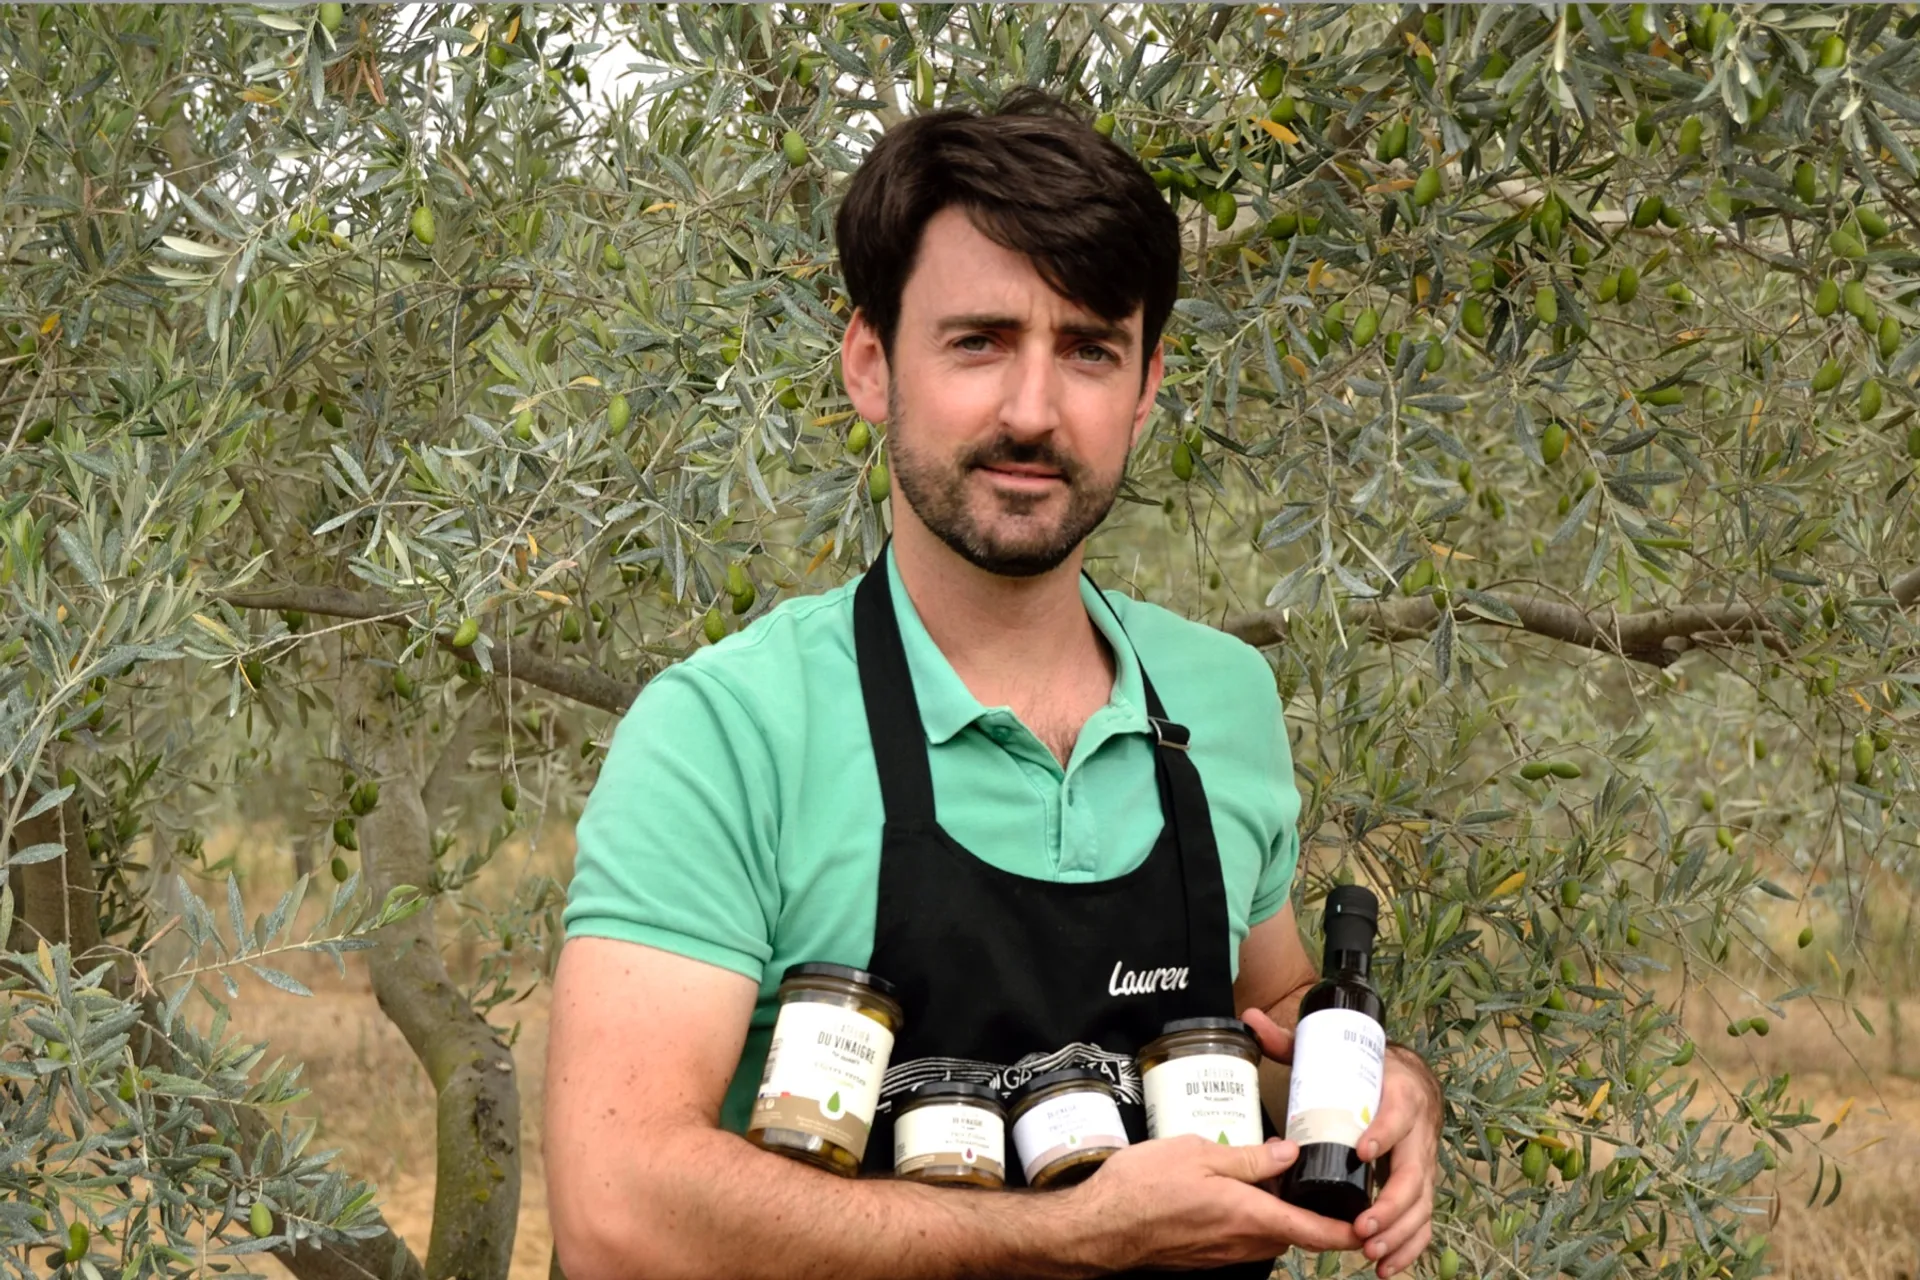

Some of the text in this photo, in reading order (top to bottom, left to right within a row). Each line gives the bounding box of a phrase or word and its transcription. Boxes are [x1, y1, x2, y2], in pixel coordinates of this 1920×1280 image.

[817, 1030, 833, 1046] DU
[834, 1034, 877, 1065] VINAIGRE
[1185, 1080, 1245, 1097] DU VINAIGRE
